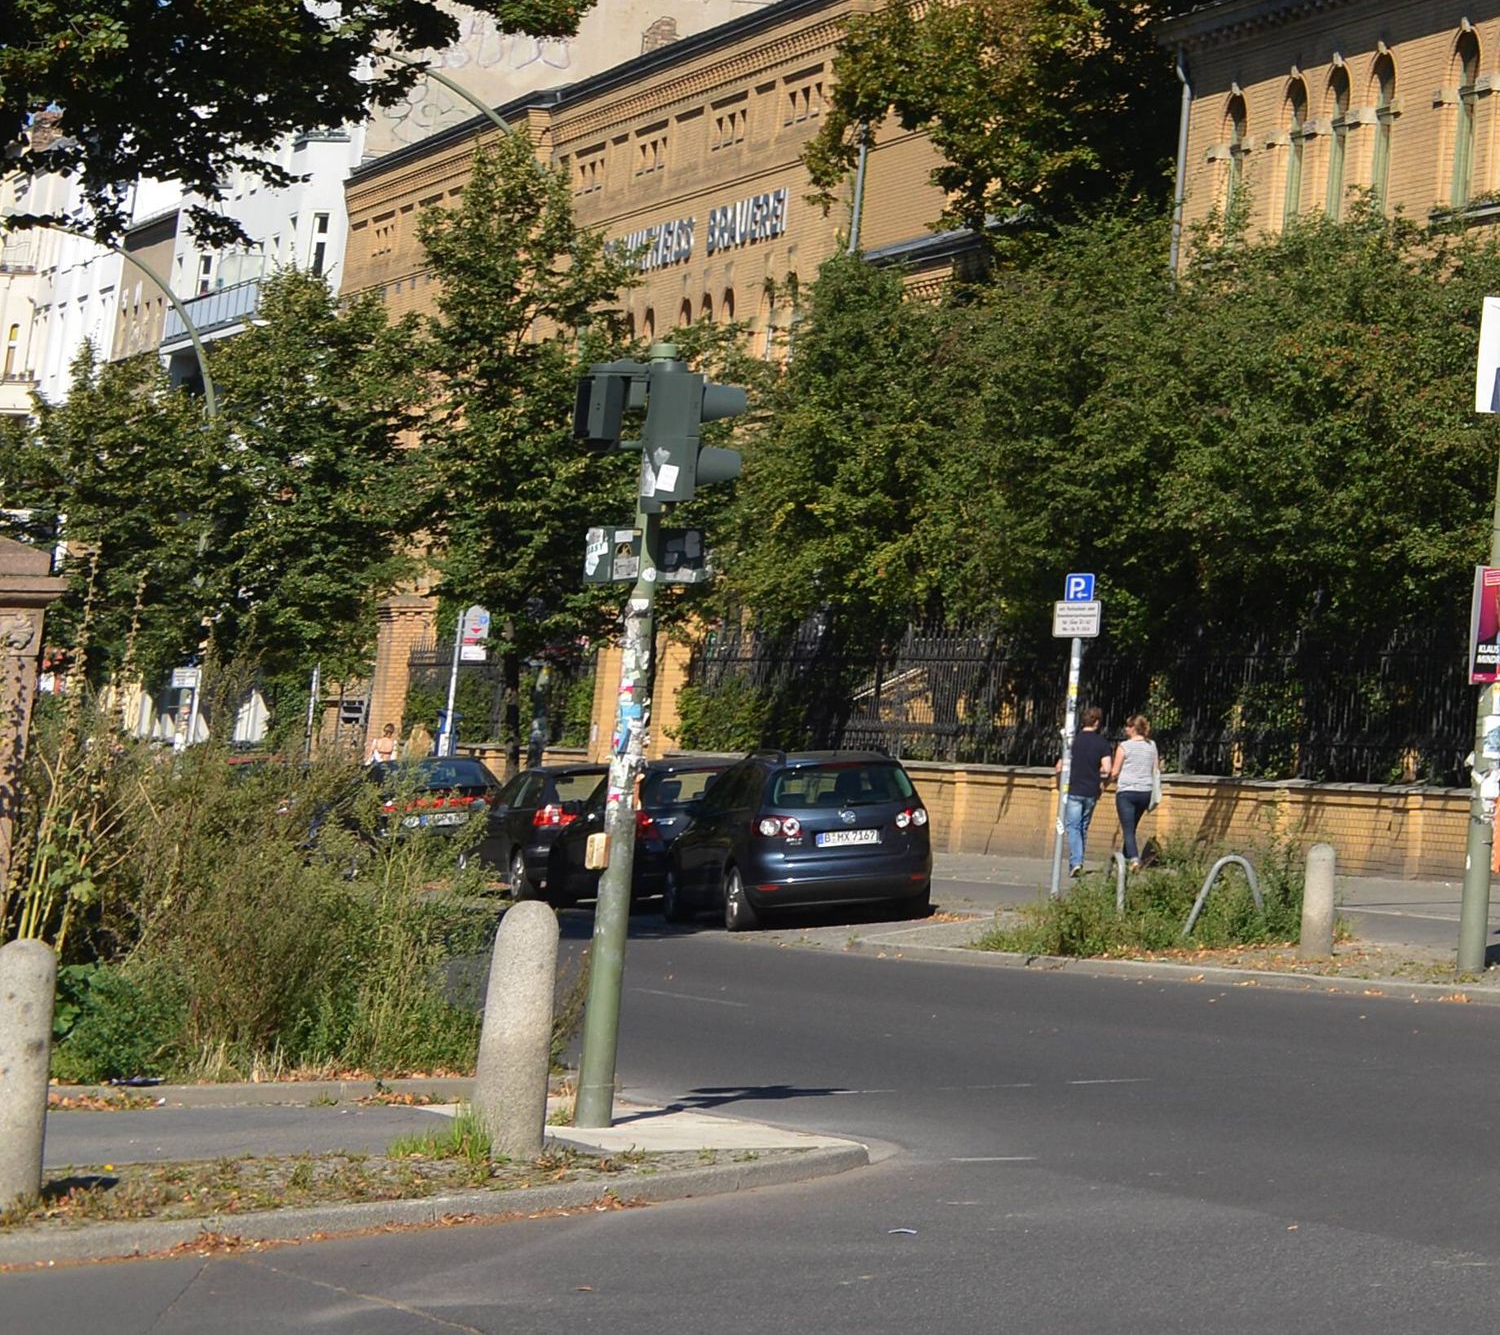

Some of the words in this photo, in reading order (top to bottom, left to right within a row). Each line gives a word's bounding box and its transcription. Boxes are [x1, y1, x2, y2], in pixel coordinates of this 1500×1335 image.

[706, 187, 789, 255] BRAUEREI
[1069, 577, 1086, 599] P
[824, 834, 831, 843] B
[852, 830, 875, 841] 7167
